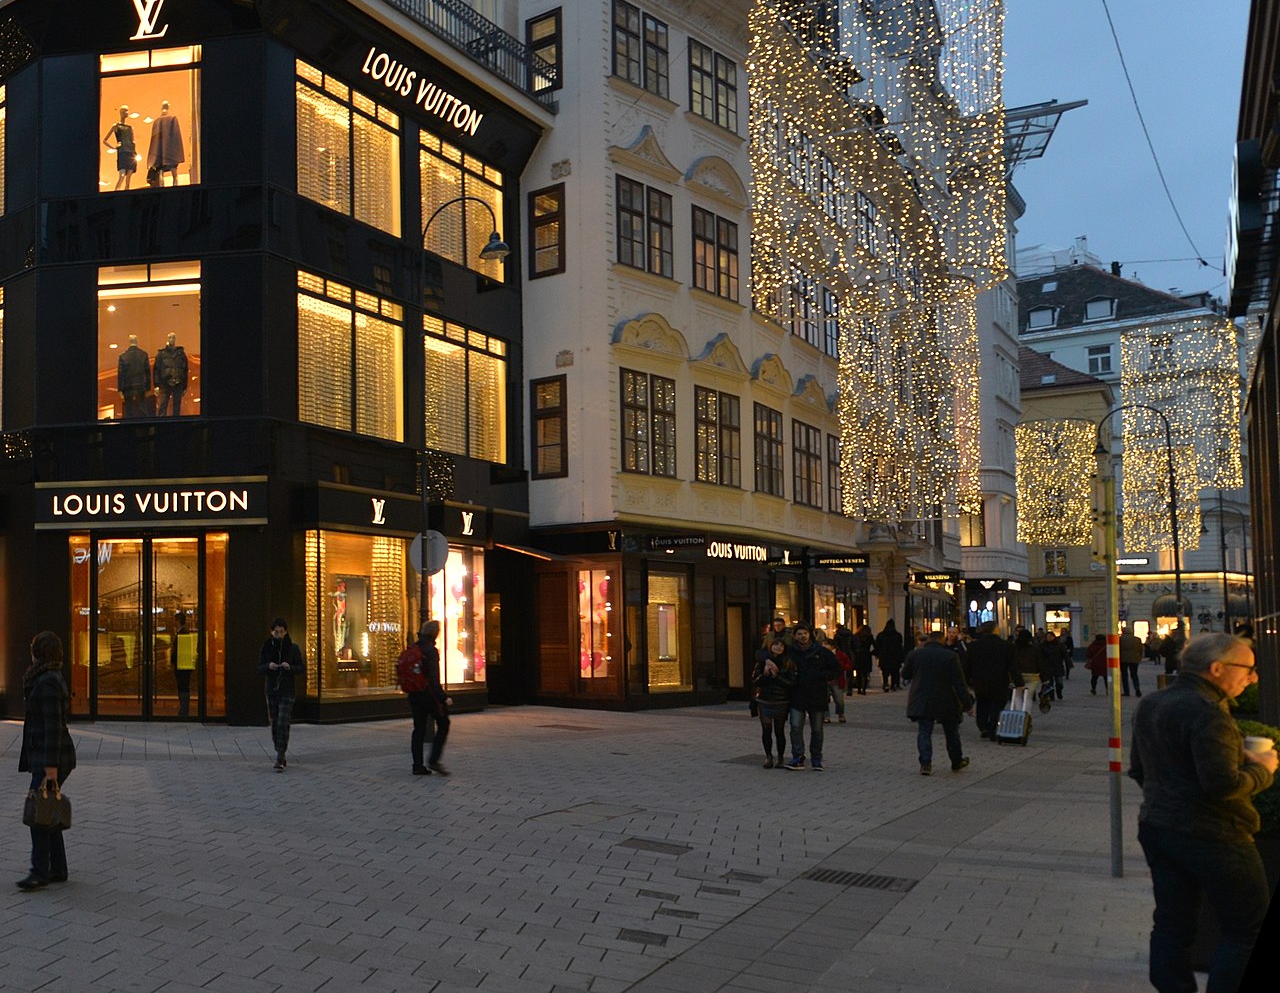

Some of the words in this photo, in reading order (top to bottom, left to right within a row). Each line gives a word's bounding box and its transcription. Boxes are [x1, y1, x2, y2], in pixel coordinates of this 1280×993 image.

[362, 47, 417, 97] LOUIS
[416, 78, 484, 136] VUITTON
[53, 493, 126, 515] LOUIS
[135, 490, 248, 513] VUITTON
[371, 498, 386, 525] LV
[461, 511, 474, 536] LV
[673, 537, 705, 545] VUITTON
[733, 543, 767, 561] VUITTON
